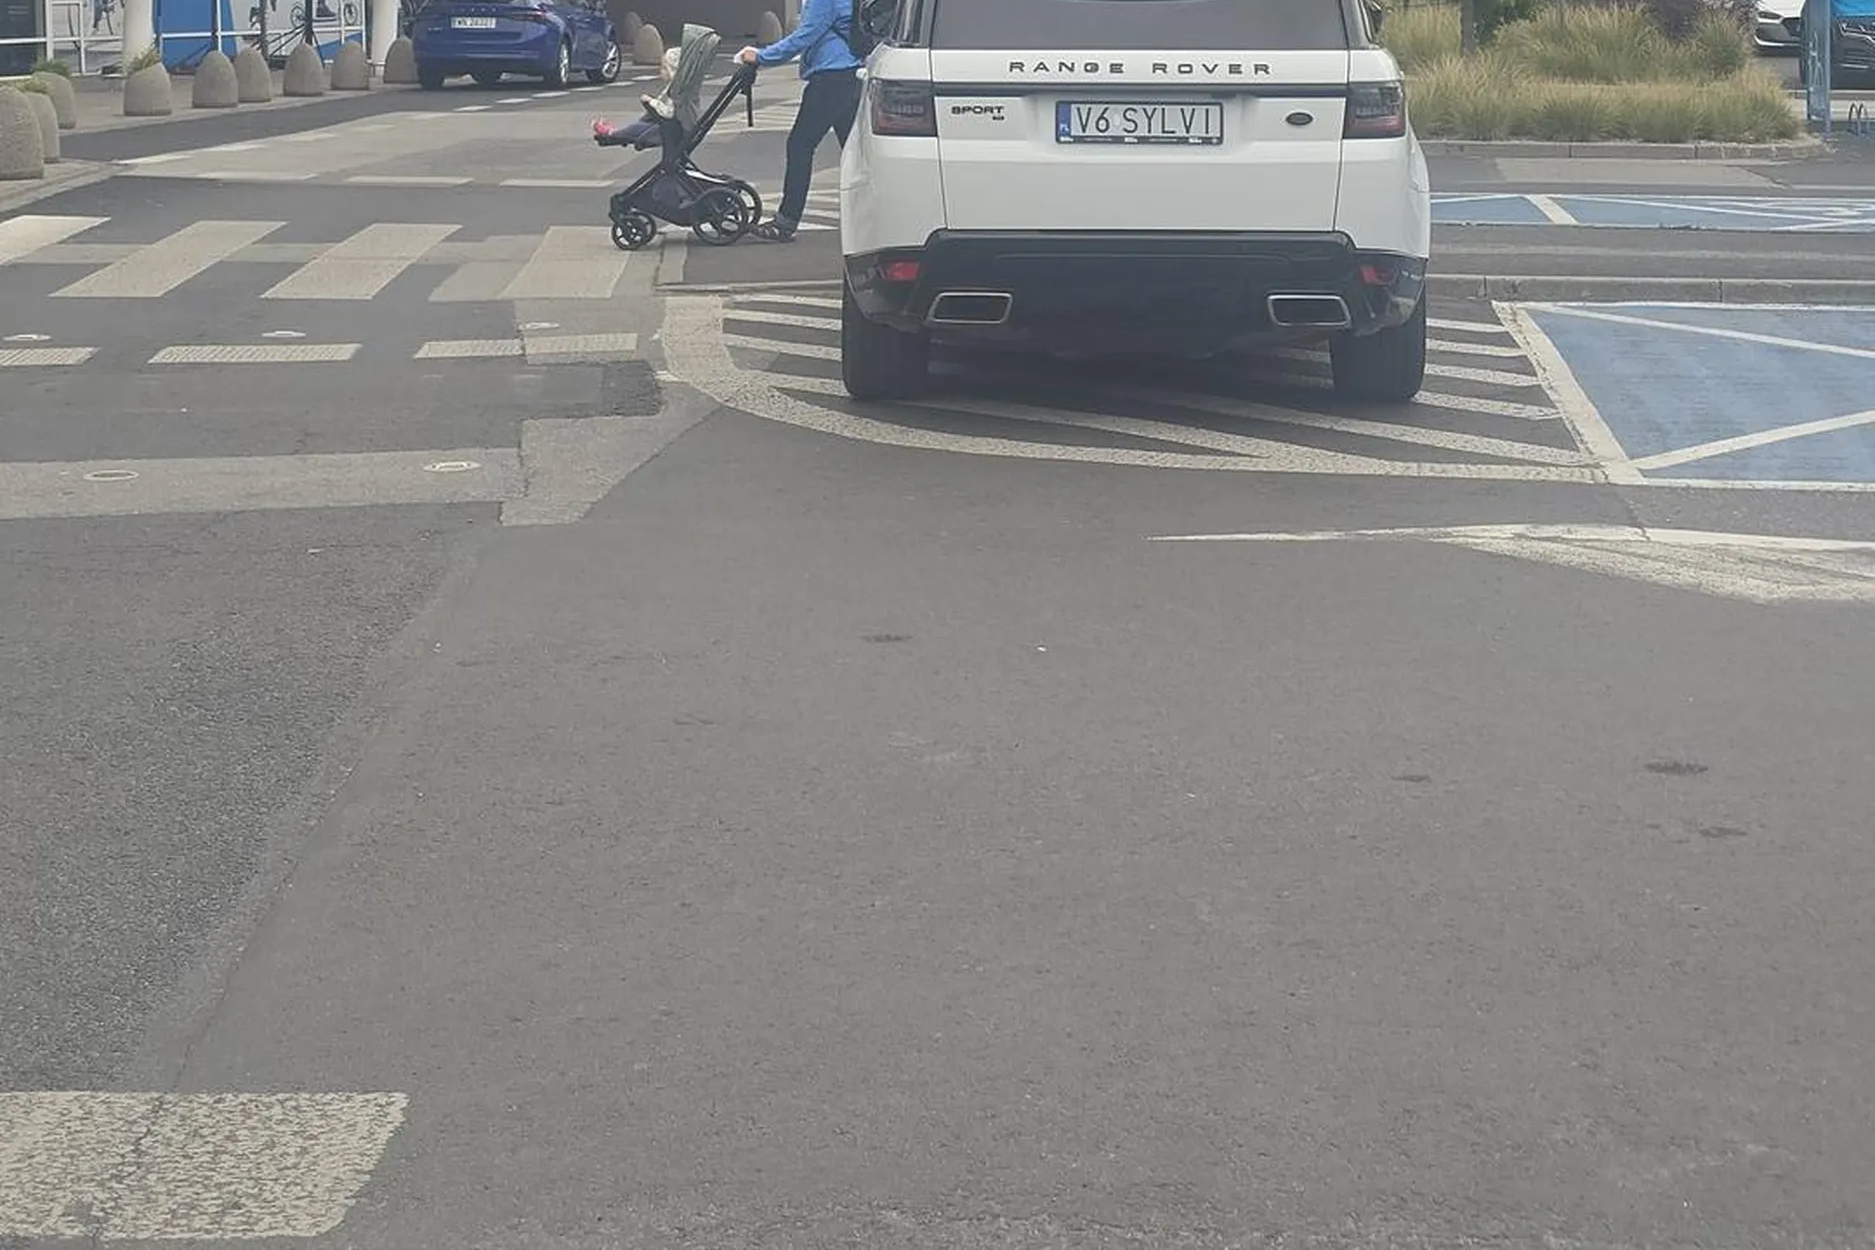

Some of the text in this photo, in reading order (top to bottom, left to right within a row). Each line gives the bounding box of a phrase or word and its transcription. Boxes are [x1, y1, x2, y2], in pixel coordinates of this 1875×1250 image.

[1009, 61, 1272, 75] RANGE ROVER
[951, 105, 1004, 115] SPORT
[1077, 106, 1210, 135] V6 SYLVI
